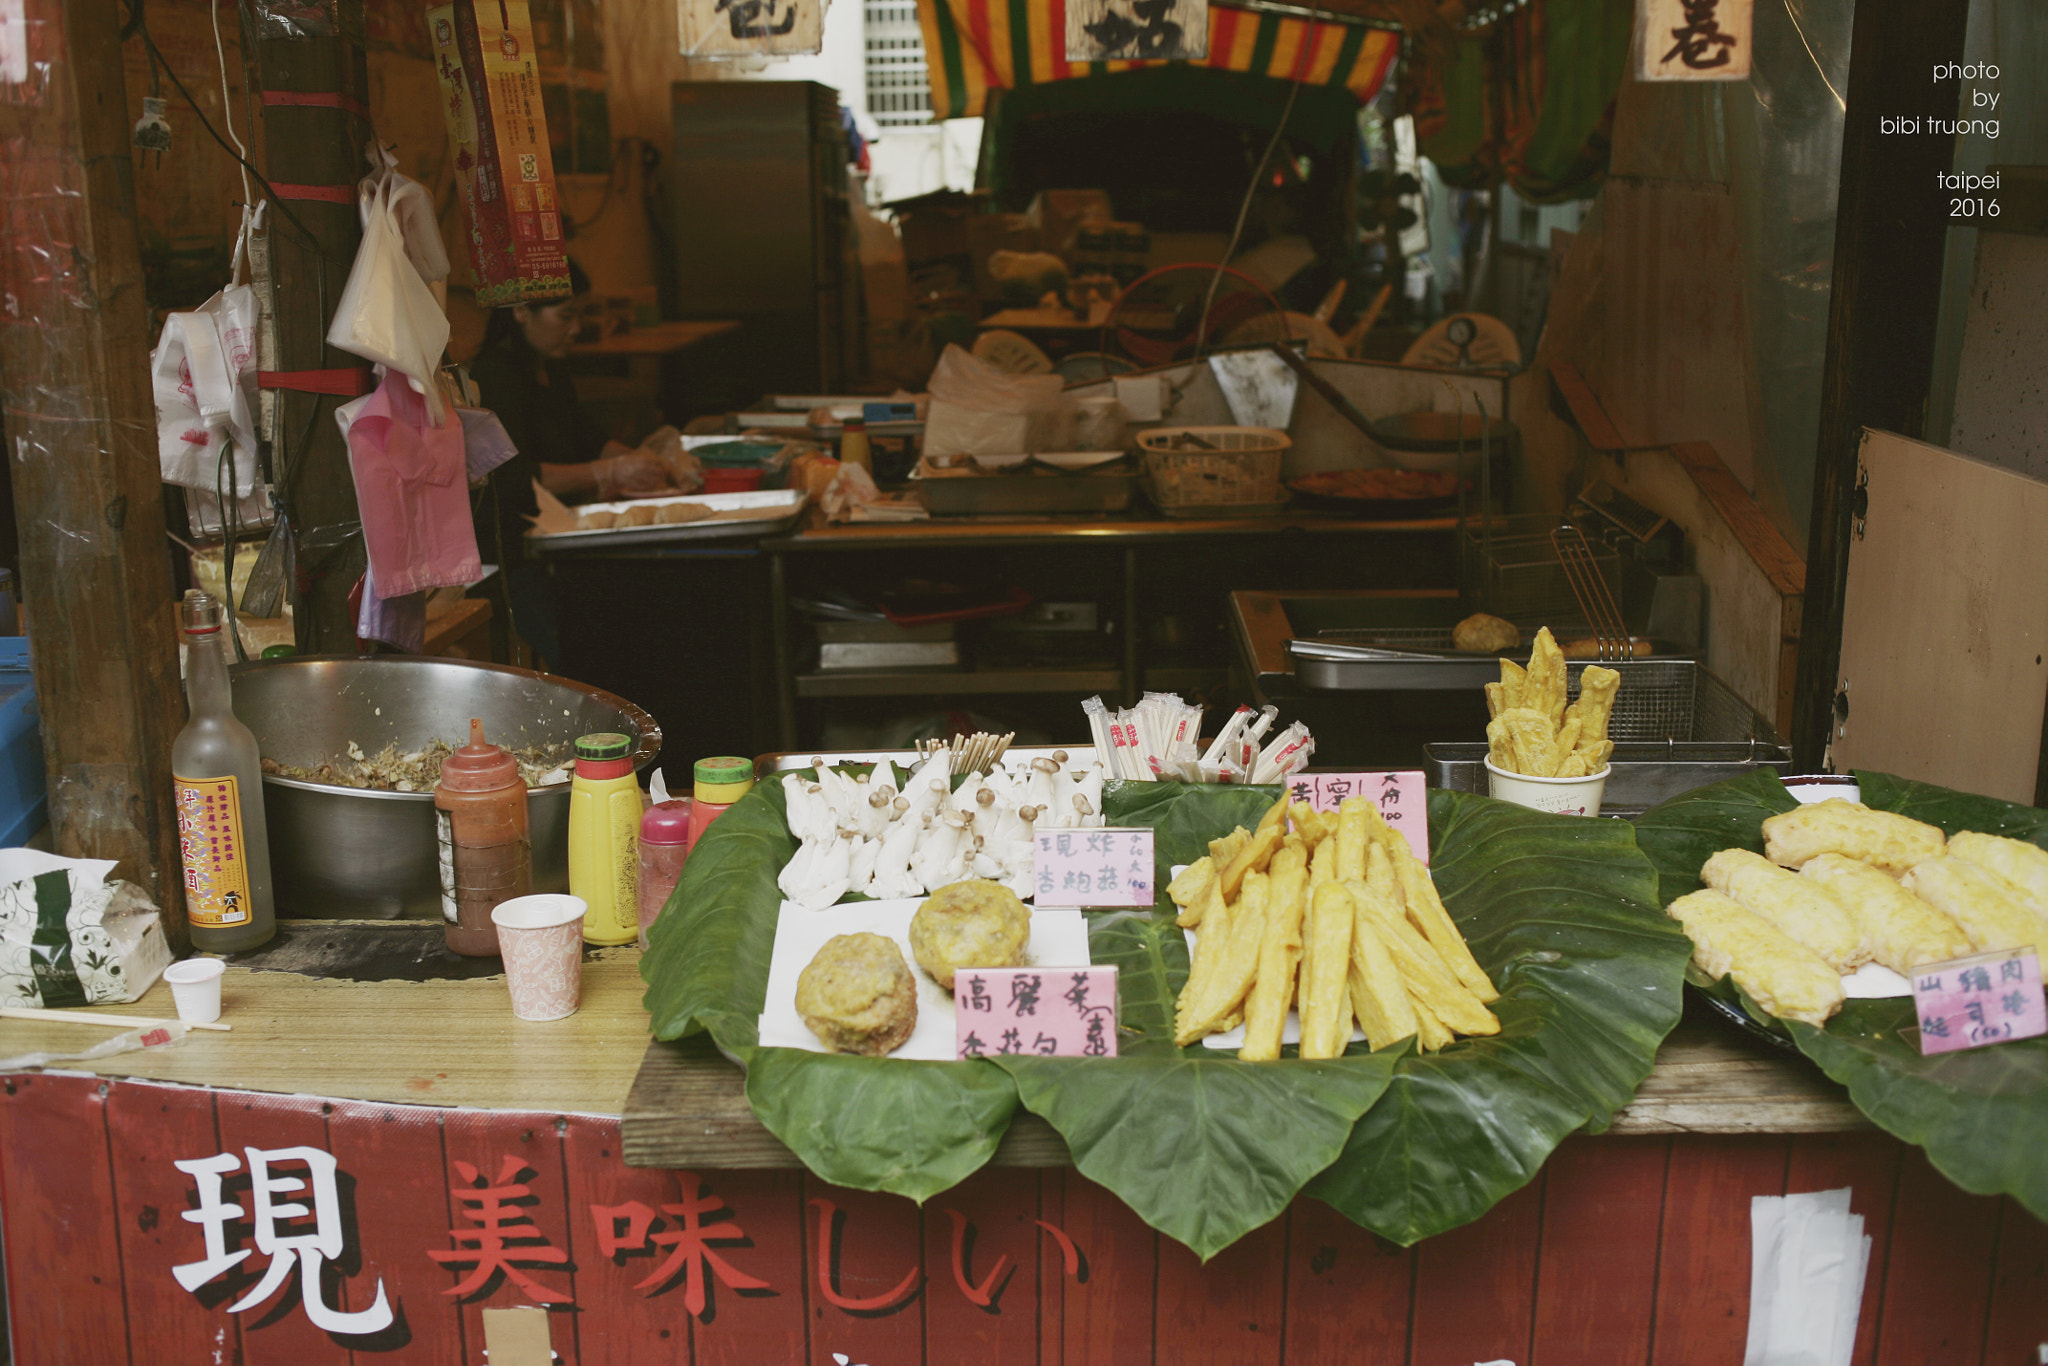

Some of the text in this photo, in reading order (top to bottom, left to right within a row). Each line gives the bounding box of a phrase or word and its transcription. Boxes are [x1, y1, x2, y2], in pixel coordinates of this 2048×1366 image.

[172, 1146, 394, 1335] 現
[427, 1154, 1080, 1318] 美味しい
